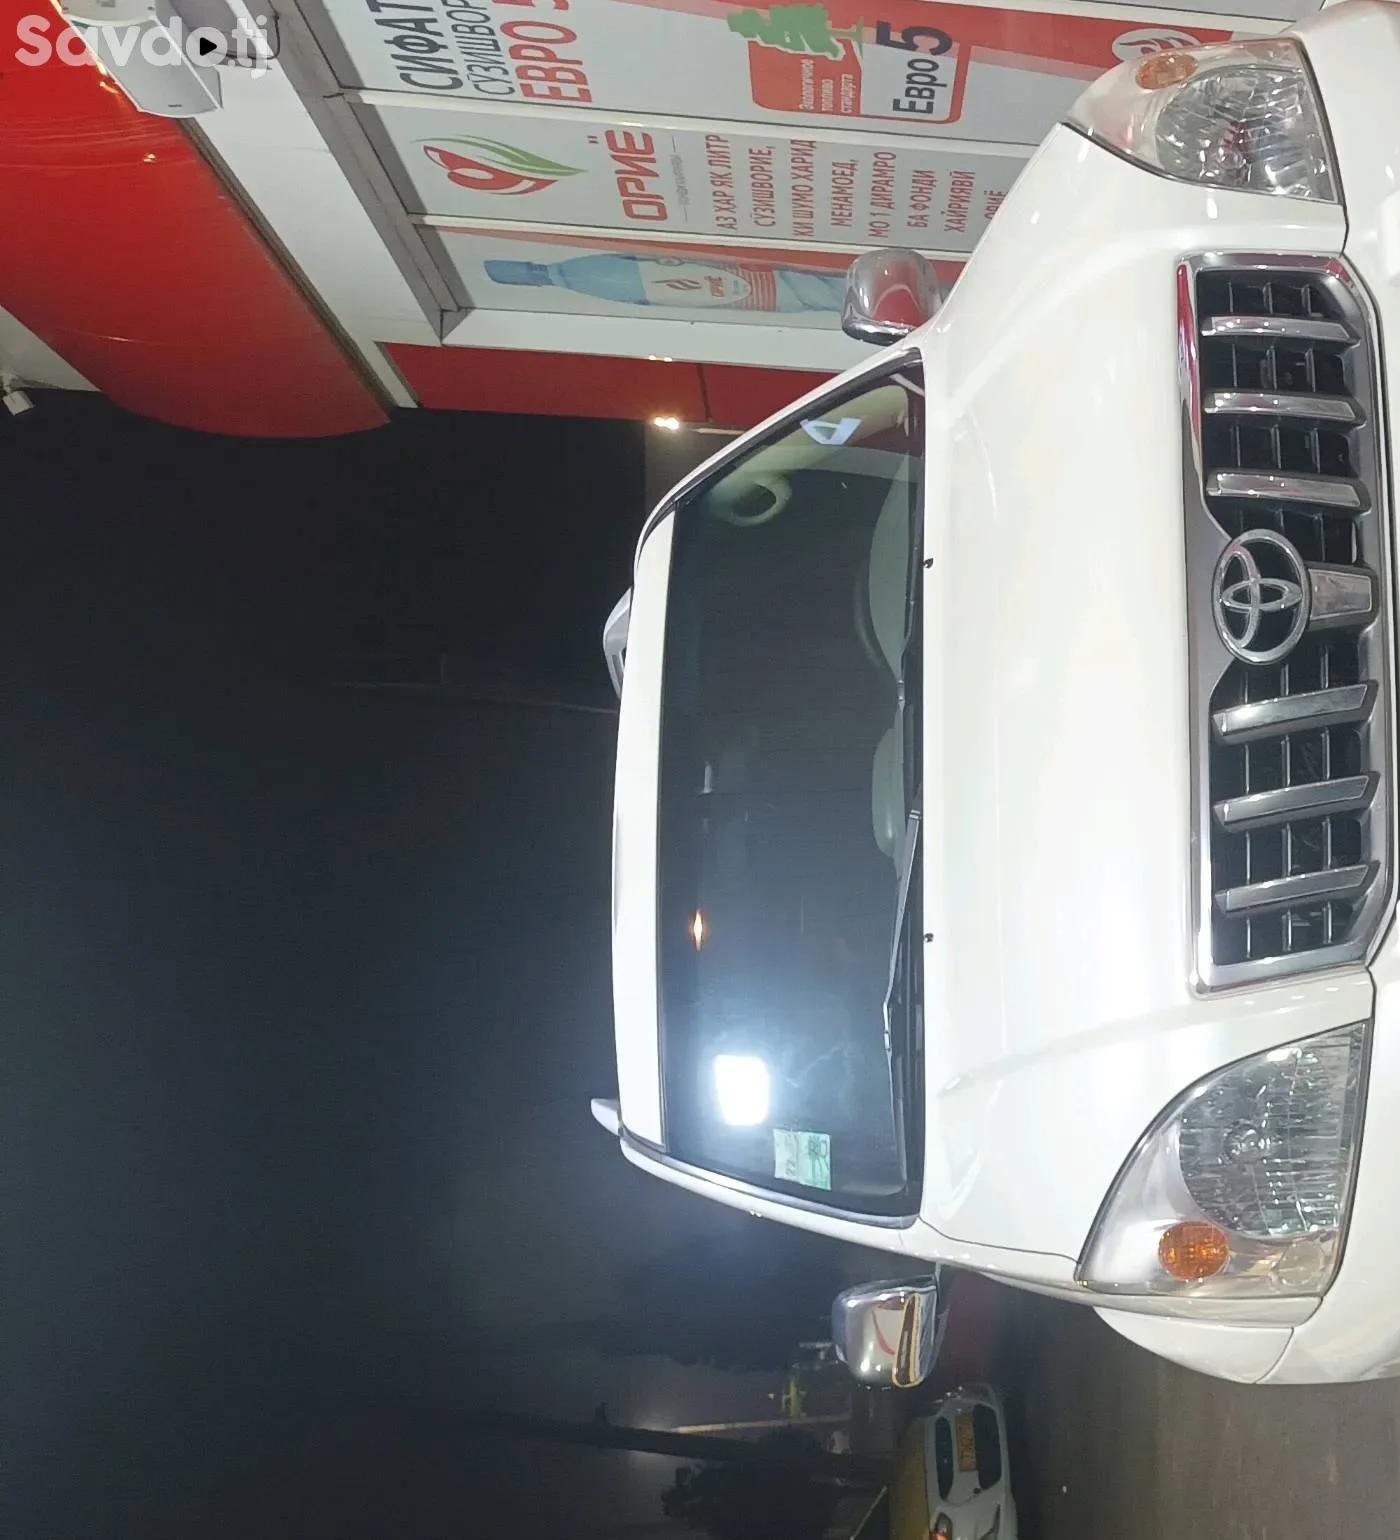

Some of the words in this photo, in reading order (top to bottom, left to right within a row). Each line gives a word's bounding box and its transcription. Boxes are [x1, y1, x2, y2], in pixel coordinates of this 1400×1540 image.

[875, 20, 953, 56] 5
[500, 20, 593, 103] ЕВРО
[892, 58, 947, 114] Евро
[705, 134, 732, 169] ЛИТР
[789, 139, 817, 182] ХАРИД
[709, 171, 733, 189] ЯК
[830, 159, 860, 227] МЕНАМОЕД,
[870, 151, 897, 210] ДИРАМРО
[909, 169, 938, 211] ФОНДИ
[791, 184, 815, 219] ШУМО
[715, 215, 738, 230] АЗ
[791, 221, 815, 237] КИ
[868, 220, 890, 238] МО
[907, 214, 930, 228] БА
